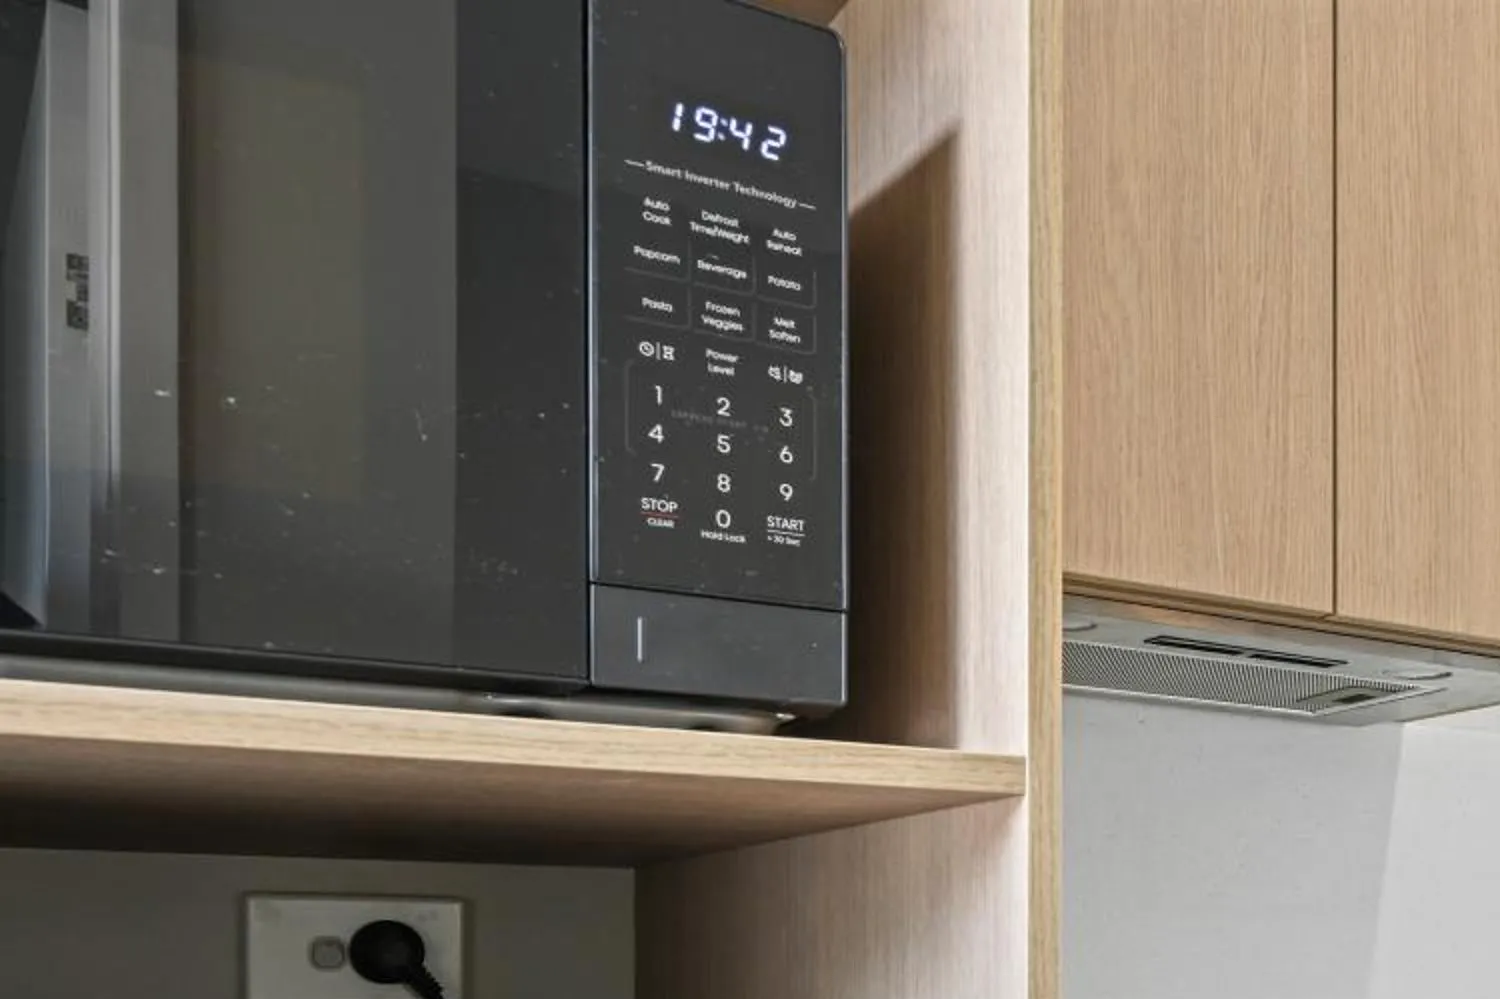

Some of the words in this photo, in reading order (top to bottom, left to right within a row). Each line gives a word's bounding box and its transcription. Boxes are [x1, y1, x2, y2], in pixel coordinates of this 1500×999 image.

[672, 103, 787, 161] 19:42
[645, 160, 682, 179] Smart
[685, 171, 730, 191] Inverter
[733, 181, 797, 208] Technology
[644, 197, 671, 212] Auto
[642, 211, 672, 226] Cook
[701, 210, 739, 228] Defrost
[772, 228, 797, 241] Auto
[633, 245, 681, 264] Popcorn
[697, 259, 747, 280] Beverage
[768, 275, 801, 291] Potato
[642, 297, 673, 313] Pasta
[705, 301, 741, 317] Frozen
[773, 316, 796, 329] Melt
[768, 329, 801, 344] Soften
[705, 348, 739, 363] Power
[707, 363, 735, 376] Level
[655, 385, 663, 405] 1
[716, 397, 731, 417] 2
[779, 407, 793, 427] 3
[648, 424, 665, 443] 4
[717, 434, 731, 453] 5
[779, 446, 793, 464] 6
[651, 463, 665, 482] 7
[717, 473, 731, 493] 8
[779, 484, 793, 501] 9
[641, 497, 678, 513] STOP
[715, 509, 731, 528] 0
[767, 515, 804, 531] START
